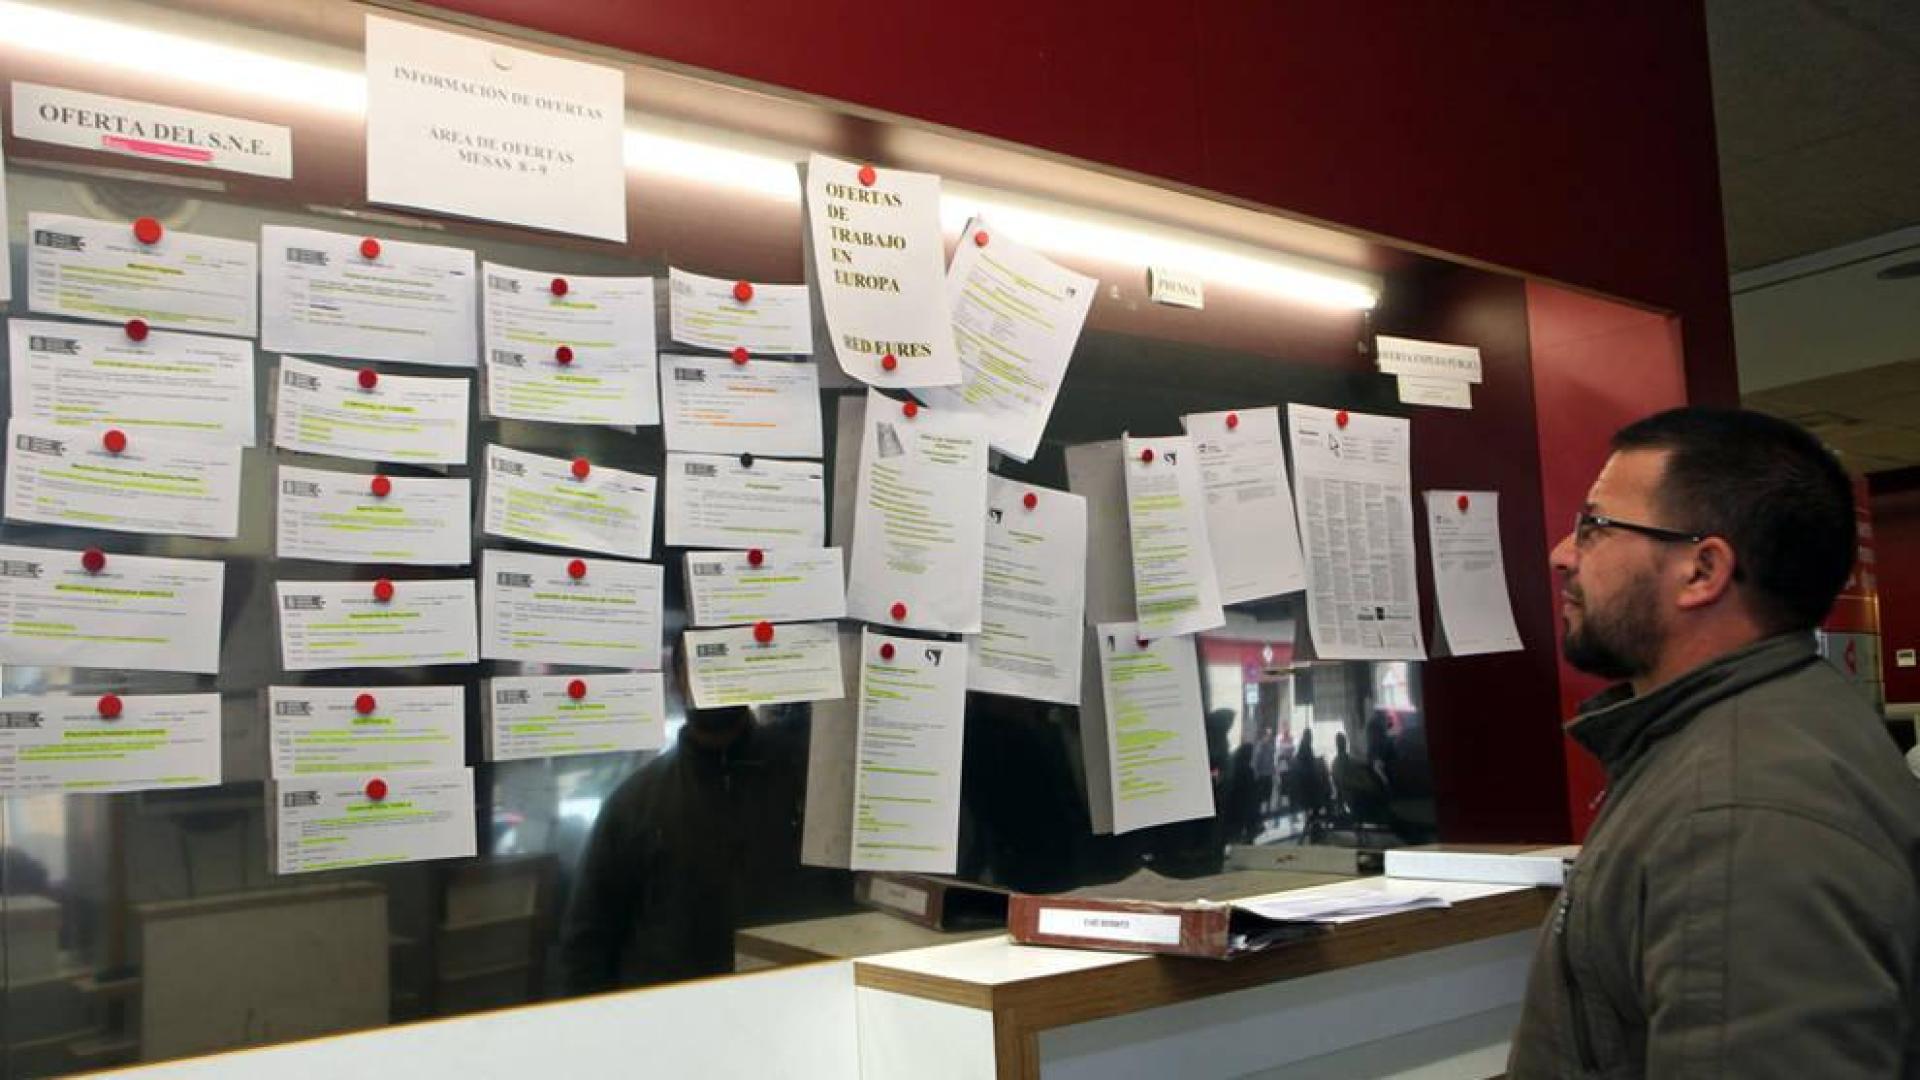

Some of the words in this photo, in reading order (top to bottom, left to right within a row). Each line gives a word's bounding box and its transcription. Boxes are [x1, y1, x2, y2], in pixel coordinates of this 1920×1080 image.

[38, 103, 145, 137] OFERTA
[153, 122, 203, 146] DEL
[208, 132, 272, 156] S.N.E.
[825, 182, 903, 207] OFERTAS
[827, 203, 850, 222] DE
[830, 226, 908, 250] TRABAJO
[831, 247, 853, 265] EN
[834, 269, 901, 293] EUROPA
[874, 338, 932, 357] EURES
